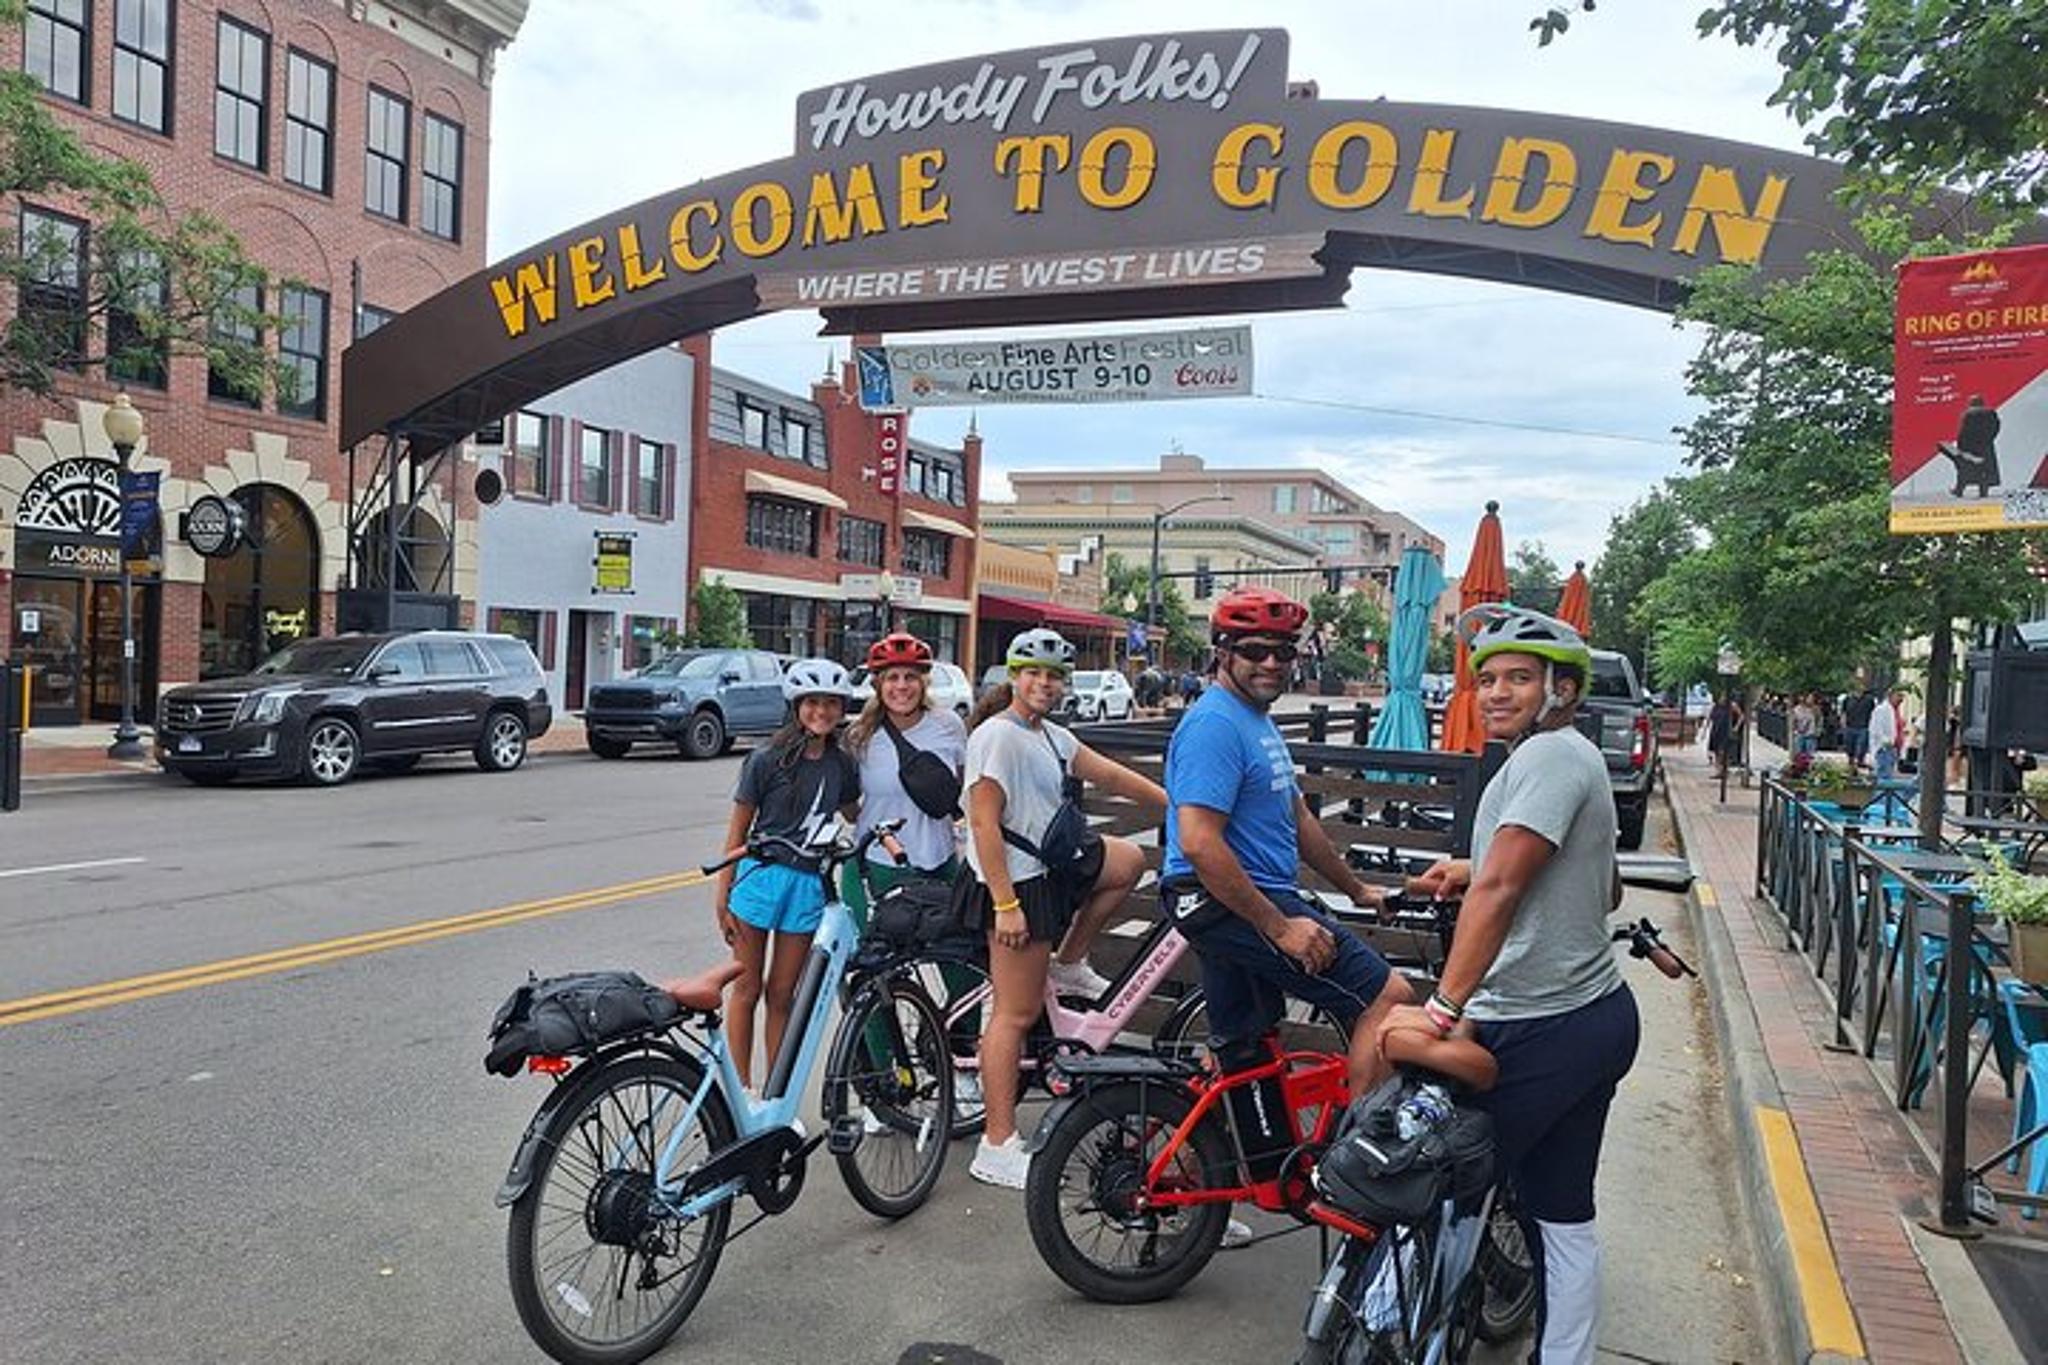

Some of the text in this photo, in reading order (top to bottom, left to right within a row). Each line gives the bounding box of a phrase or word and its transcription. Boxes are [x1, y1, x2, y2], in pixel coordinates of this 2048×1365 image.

[810, 33, 1262, 149] Howdy Folks!
[490, 120, 1793, 336] WELCOME TO GOLDEN
[798, 245, 1267, 300] WHERE THE WEST LIVES
[1904, 312, 1962, 335] RING
[1966, 308, 1998, 330] OF
[890, 346, 998, 371] Golden
[1000, 343, 1056, 367] Fine
[1064, 339, 1116, 365] Arts
[967, 366, 1079, 392] AUGUST
[1094, 362, 1151, 387] 9-10
[881, 417, 897, 491] ROSE
